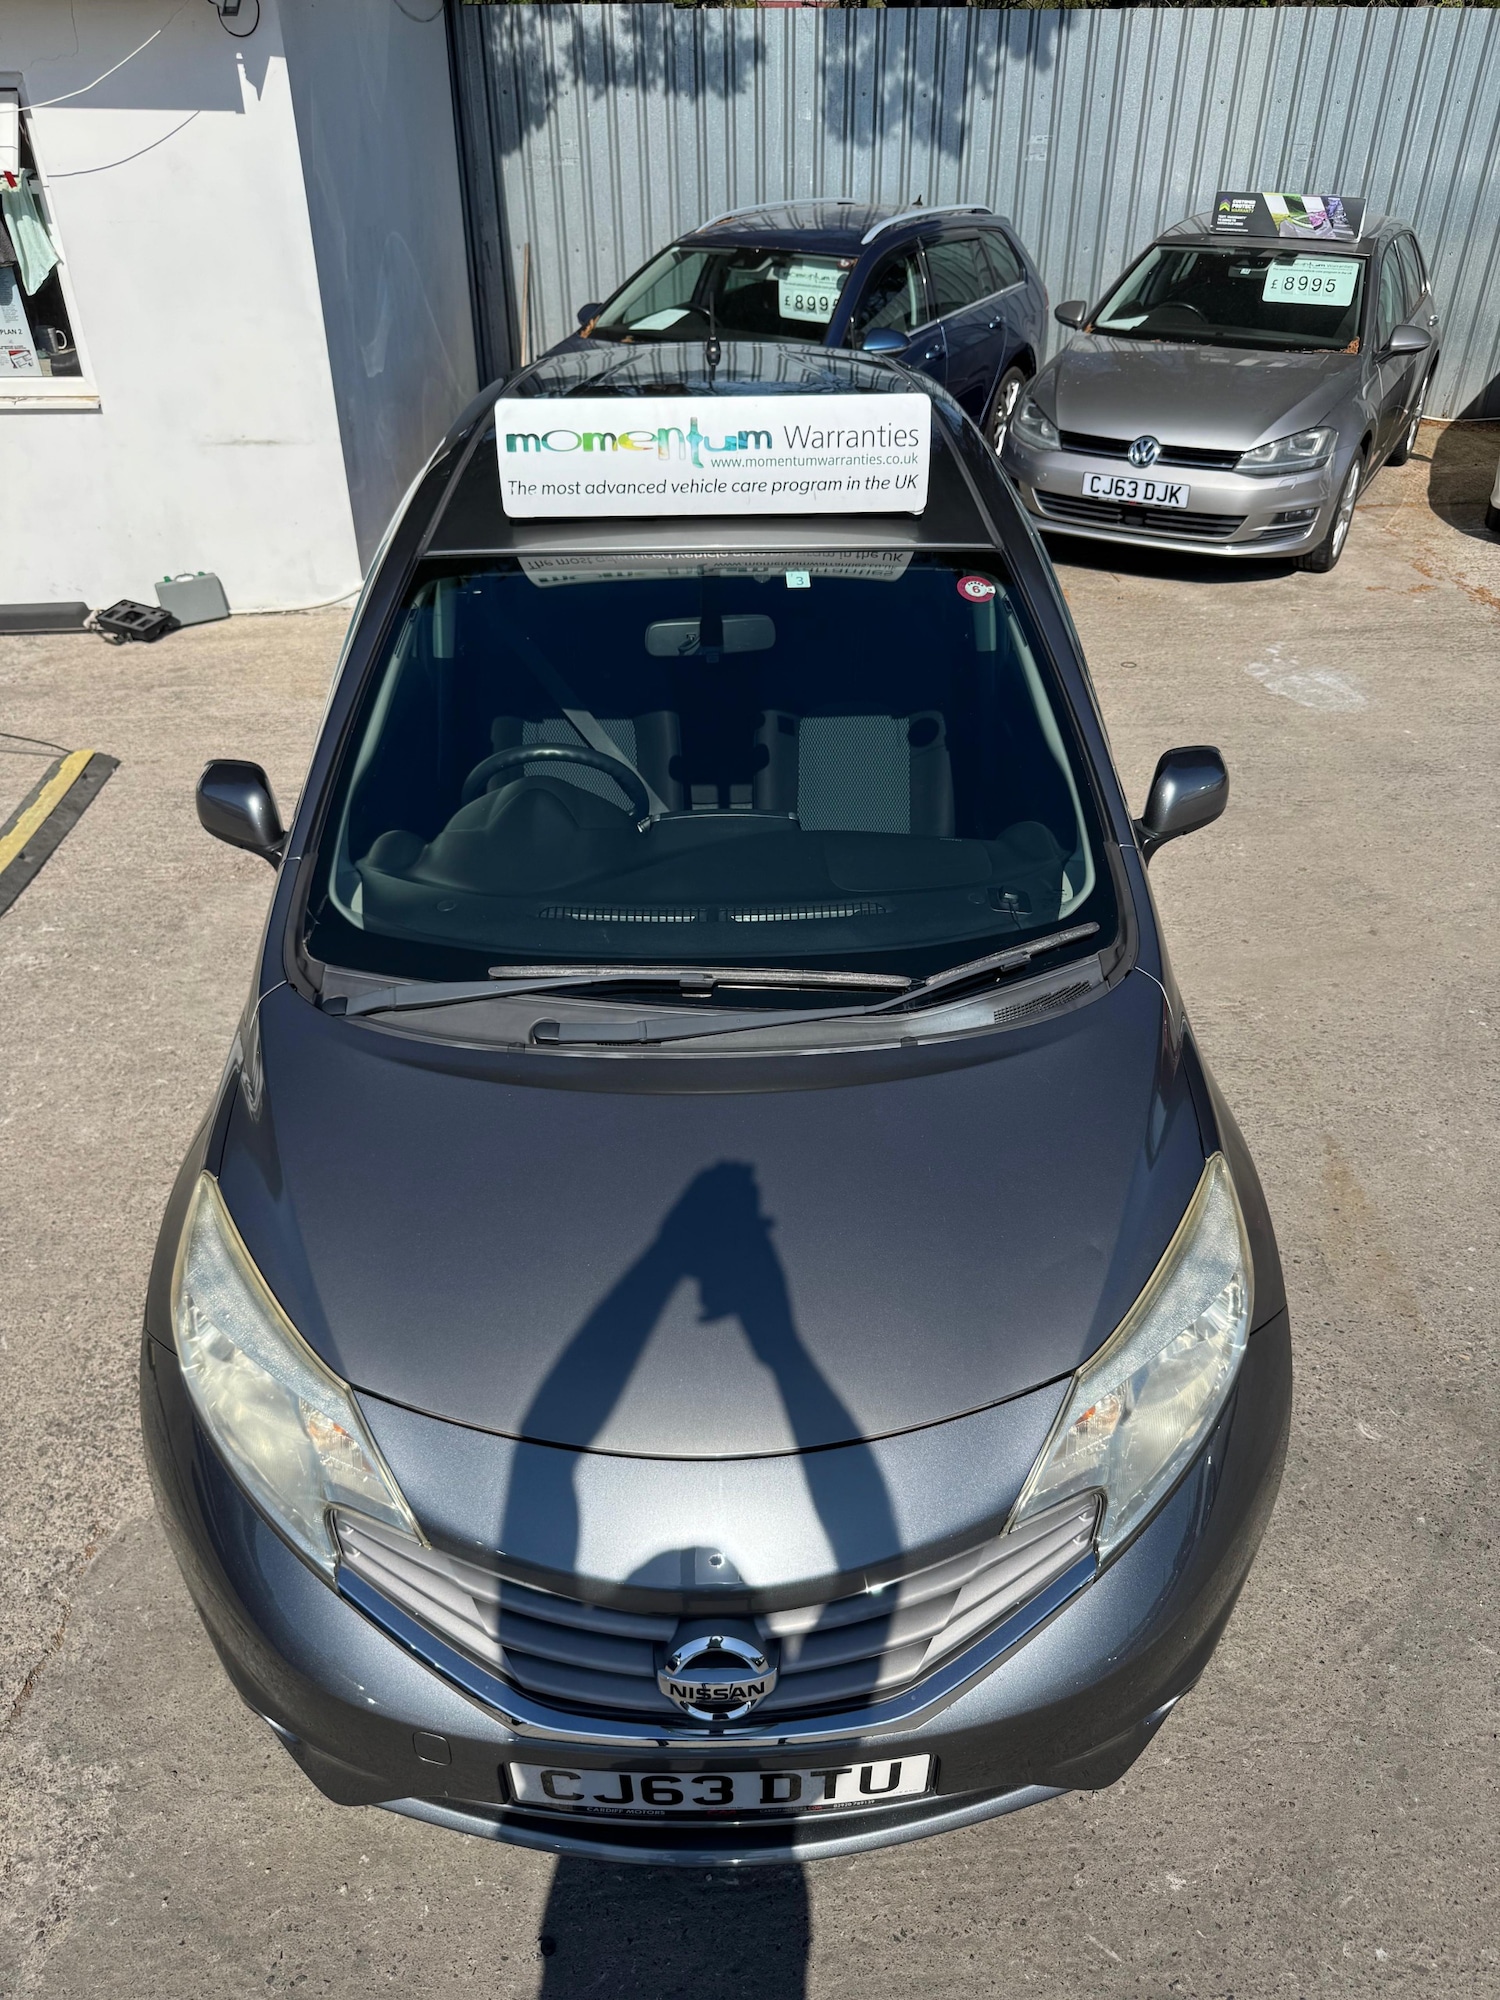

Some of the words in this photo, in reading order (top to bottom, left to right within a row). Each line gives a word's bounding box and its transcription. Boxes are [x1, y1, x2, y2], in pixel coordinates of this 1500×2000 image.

[1271, 279, 1278, 289] £
[1284, 276, 1336, 293] 8995
[785, 296, 791, 306] £
[506, 416, 773, 468] momentum
[783, 422, 919, 449] Warranties
[710, 452, 919, 468] www.momentumwarranties.co.uk
[508, 480, 537, 496] The
[541, 480, 581, 495] most
[589, 479, 667, 495] advanced
[671, 477, 728, 493] vehicle
[731, 479, 767, 493] care
[771, 478, 842, 496] program
[846, 475, 860, 491] in
[865, 475, 891, 490] the
[895, 474, 919, 489] UK
[1090, 476, 1138, 498] CJ63
[1143, 482, 1182, 504] DJK
[796, 576, 804, 586] 3
[670, 1681, 765, 1701] NISSAN
[539, 1769, 735, 1806] CJ63
[758, 1761, 904, 1804] DTU
[586, 1806, 624, 1814] CARDIFF
[625, 1808, 666, 1816] MOTORS
